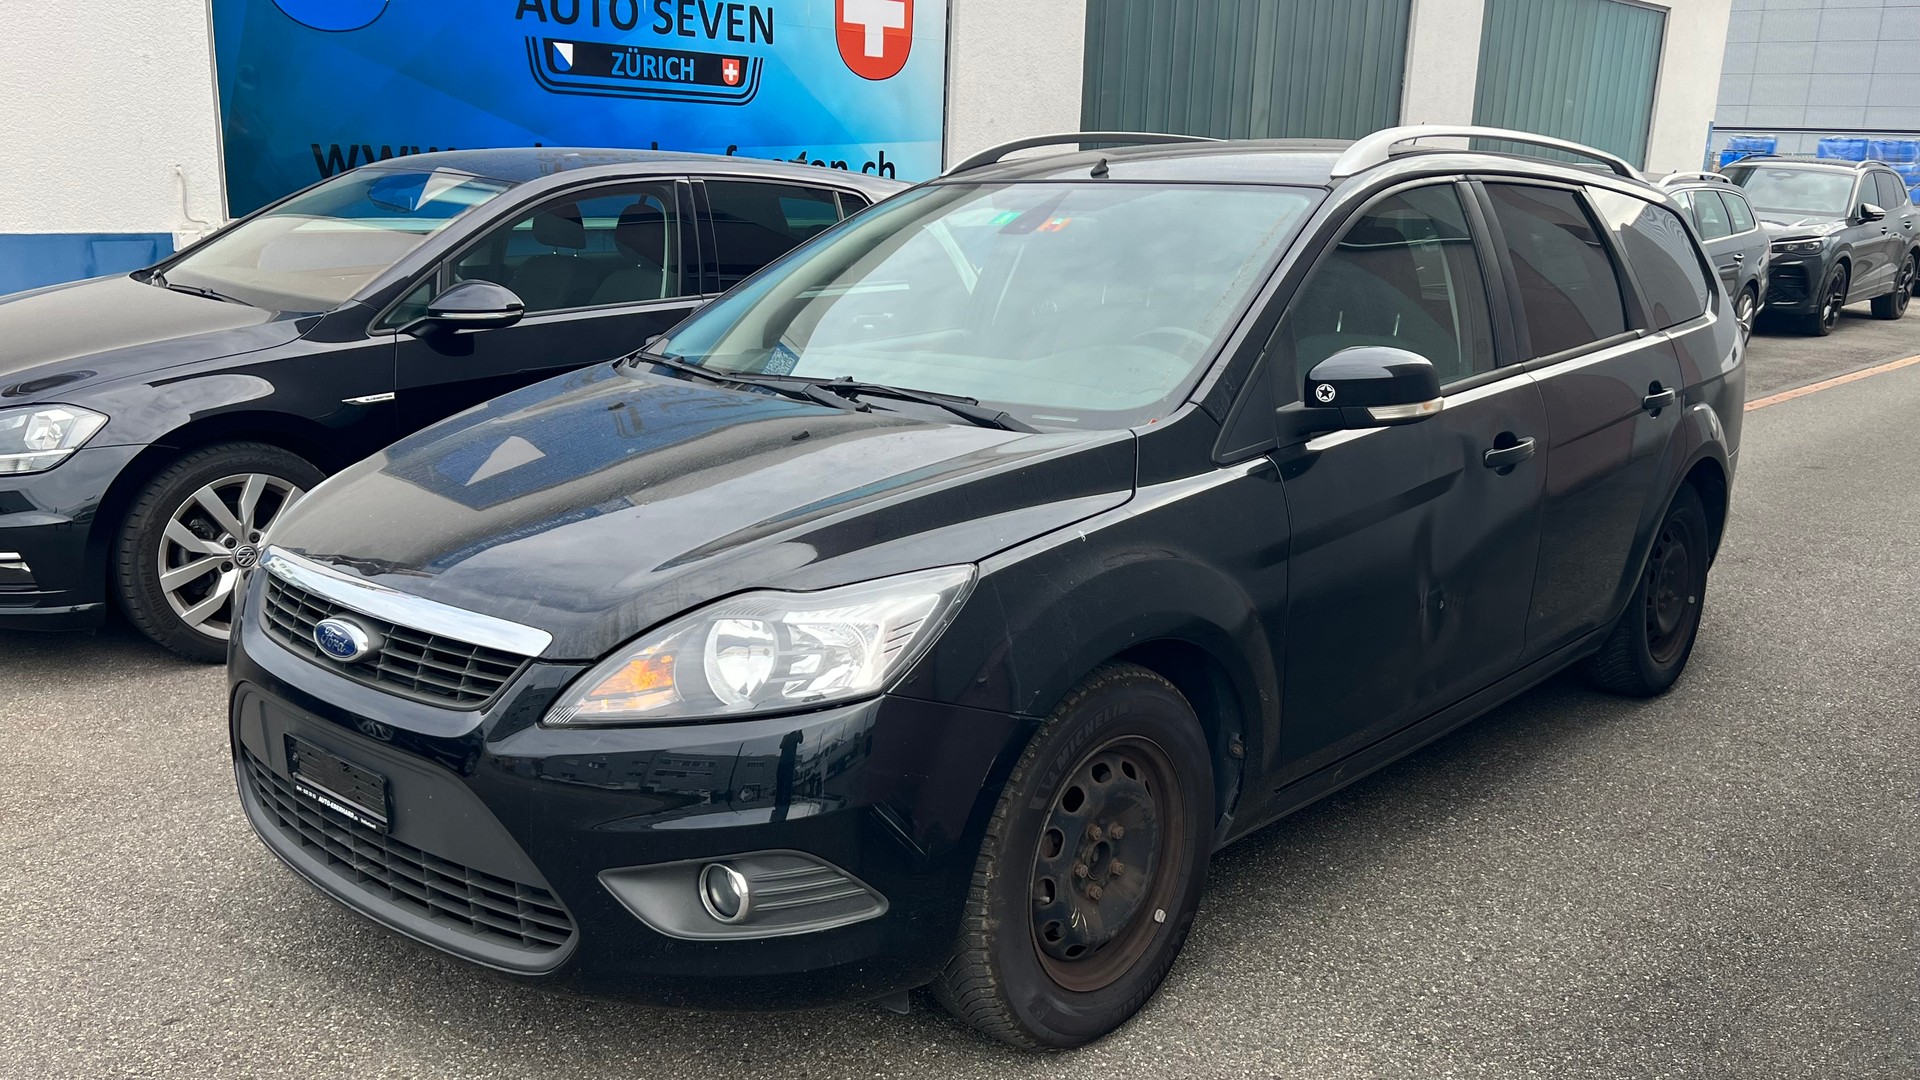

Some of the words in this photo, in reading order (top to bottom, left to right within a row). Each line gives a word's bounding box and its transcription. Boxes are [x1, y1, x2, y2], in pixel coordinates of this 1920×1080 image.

[515, 0, 639, 31] AUTO
[653, 0, 773, 45] SEVEN
[611, 47, 695, 81] ZÜRICH
[320, 626, 348, 653] Ford
